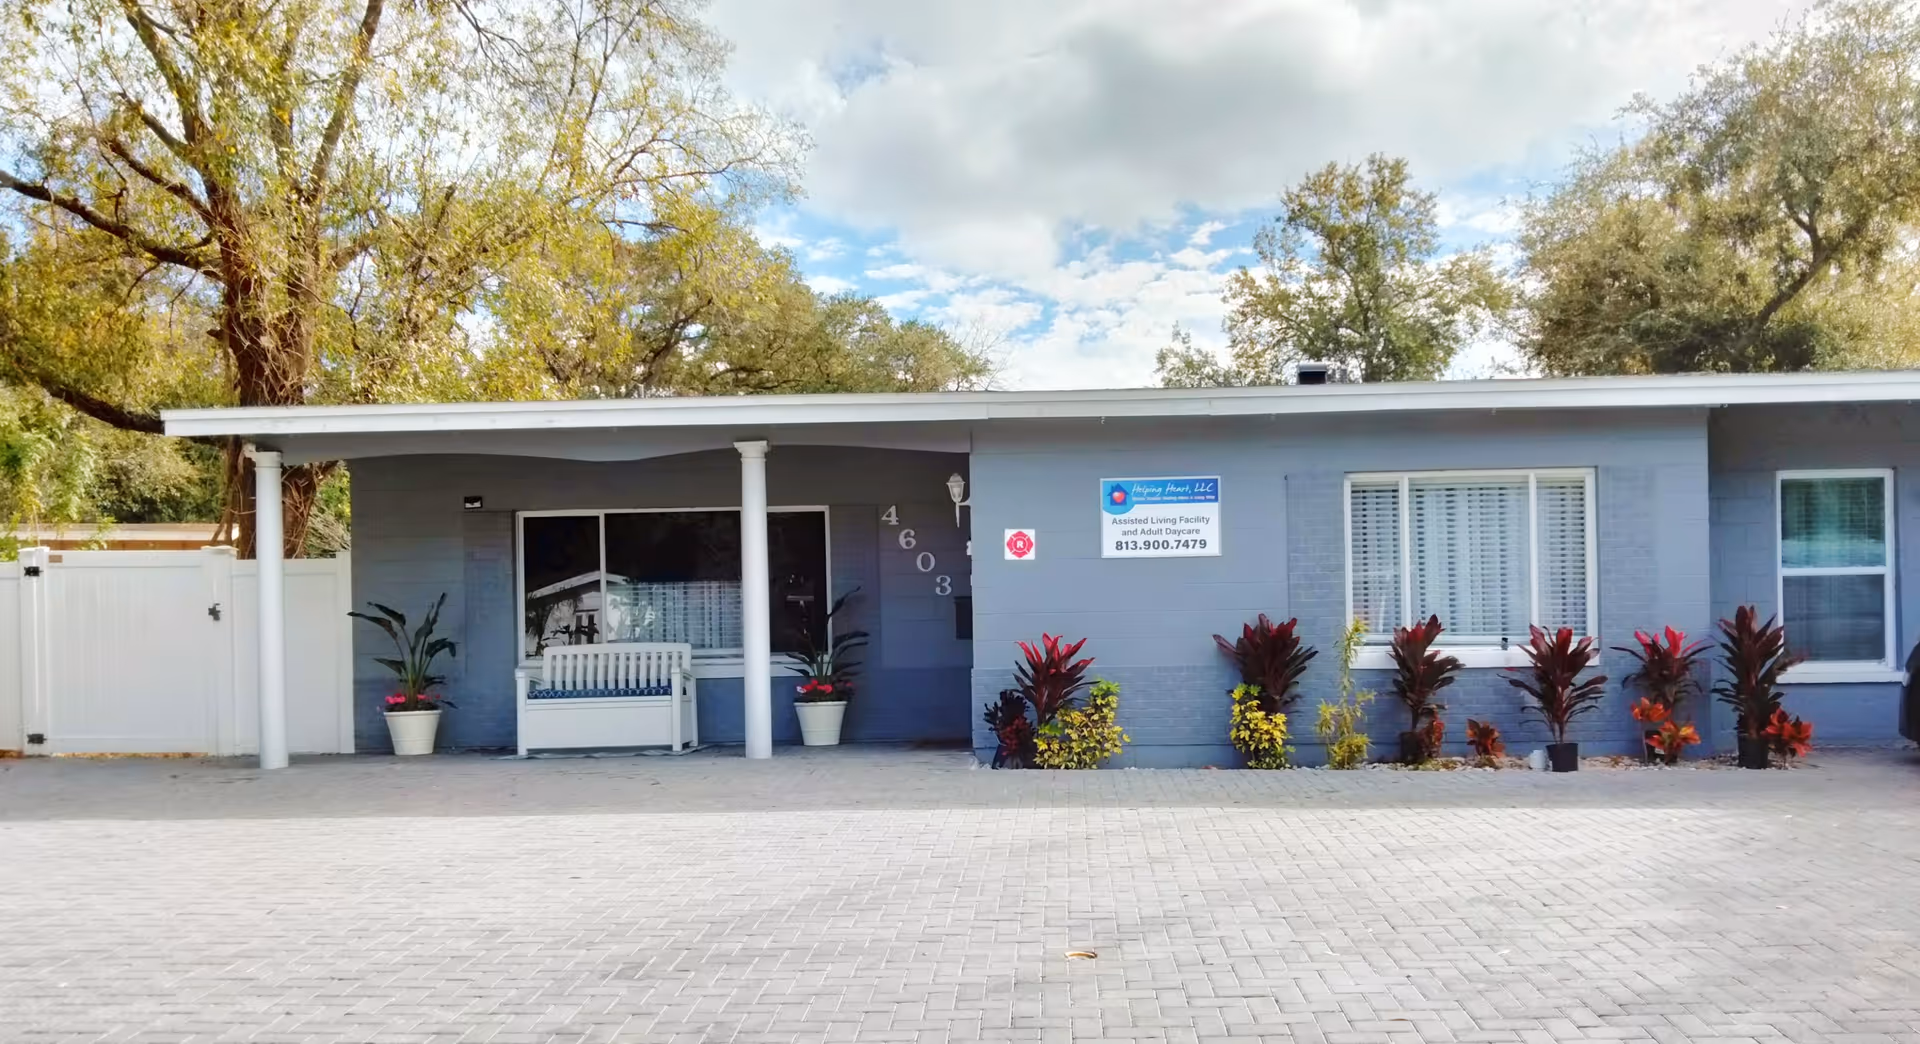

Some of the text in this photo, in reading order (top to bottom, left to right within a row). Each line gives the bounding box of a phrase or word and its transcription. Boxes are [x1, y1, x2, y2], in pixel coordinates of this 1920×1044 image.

[1131, 483, 1163, 496] Helping
[1194, 482, 1214, 492] LLC
[1111, 515, 1211, 525] Assisted Living Facility
[1121, 527, 1201, 537] and Adult Daycare
[1016, 540, 1025, 549] R
[1115, 539, 1207, 551] 813.900.7479
